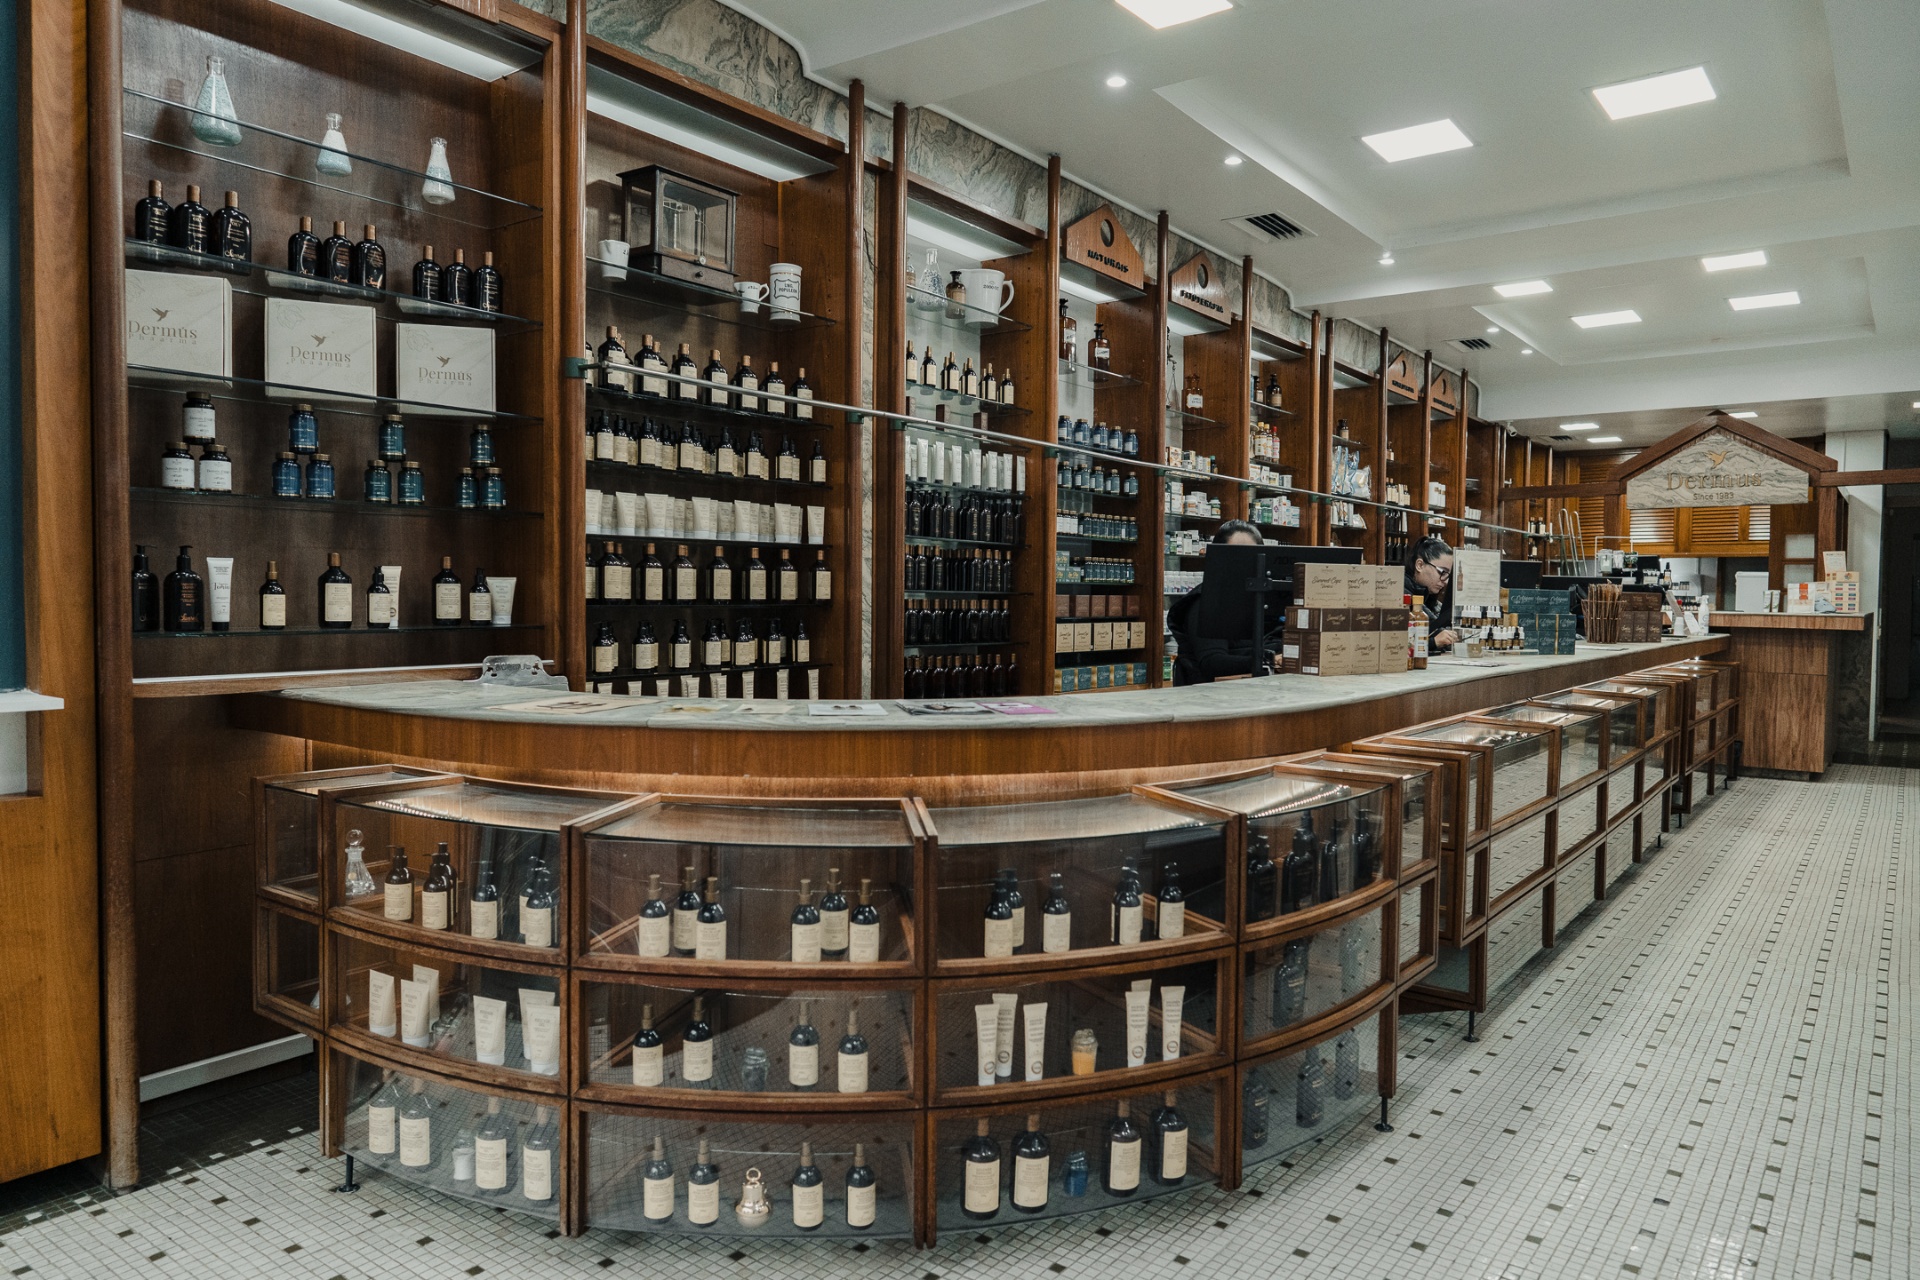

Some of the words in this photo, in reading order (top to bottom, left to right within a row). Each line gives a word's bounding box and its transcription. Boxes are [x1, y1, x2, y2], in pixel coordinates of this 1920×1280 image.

[1087, 249, 1129, 273] NATURAIS
[1666, 472, 1762, 490] Dermus
[1715, 492, 1734, 500] 1983
